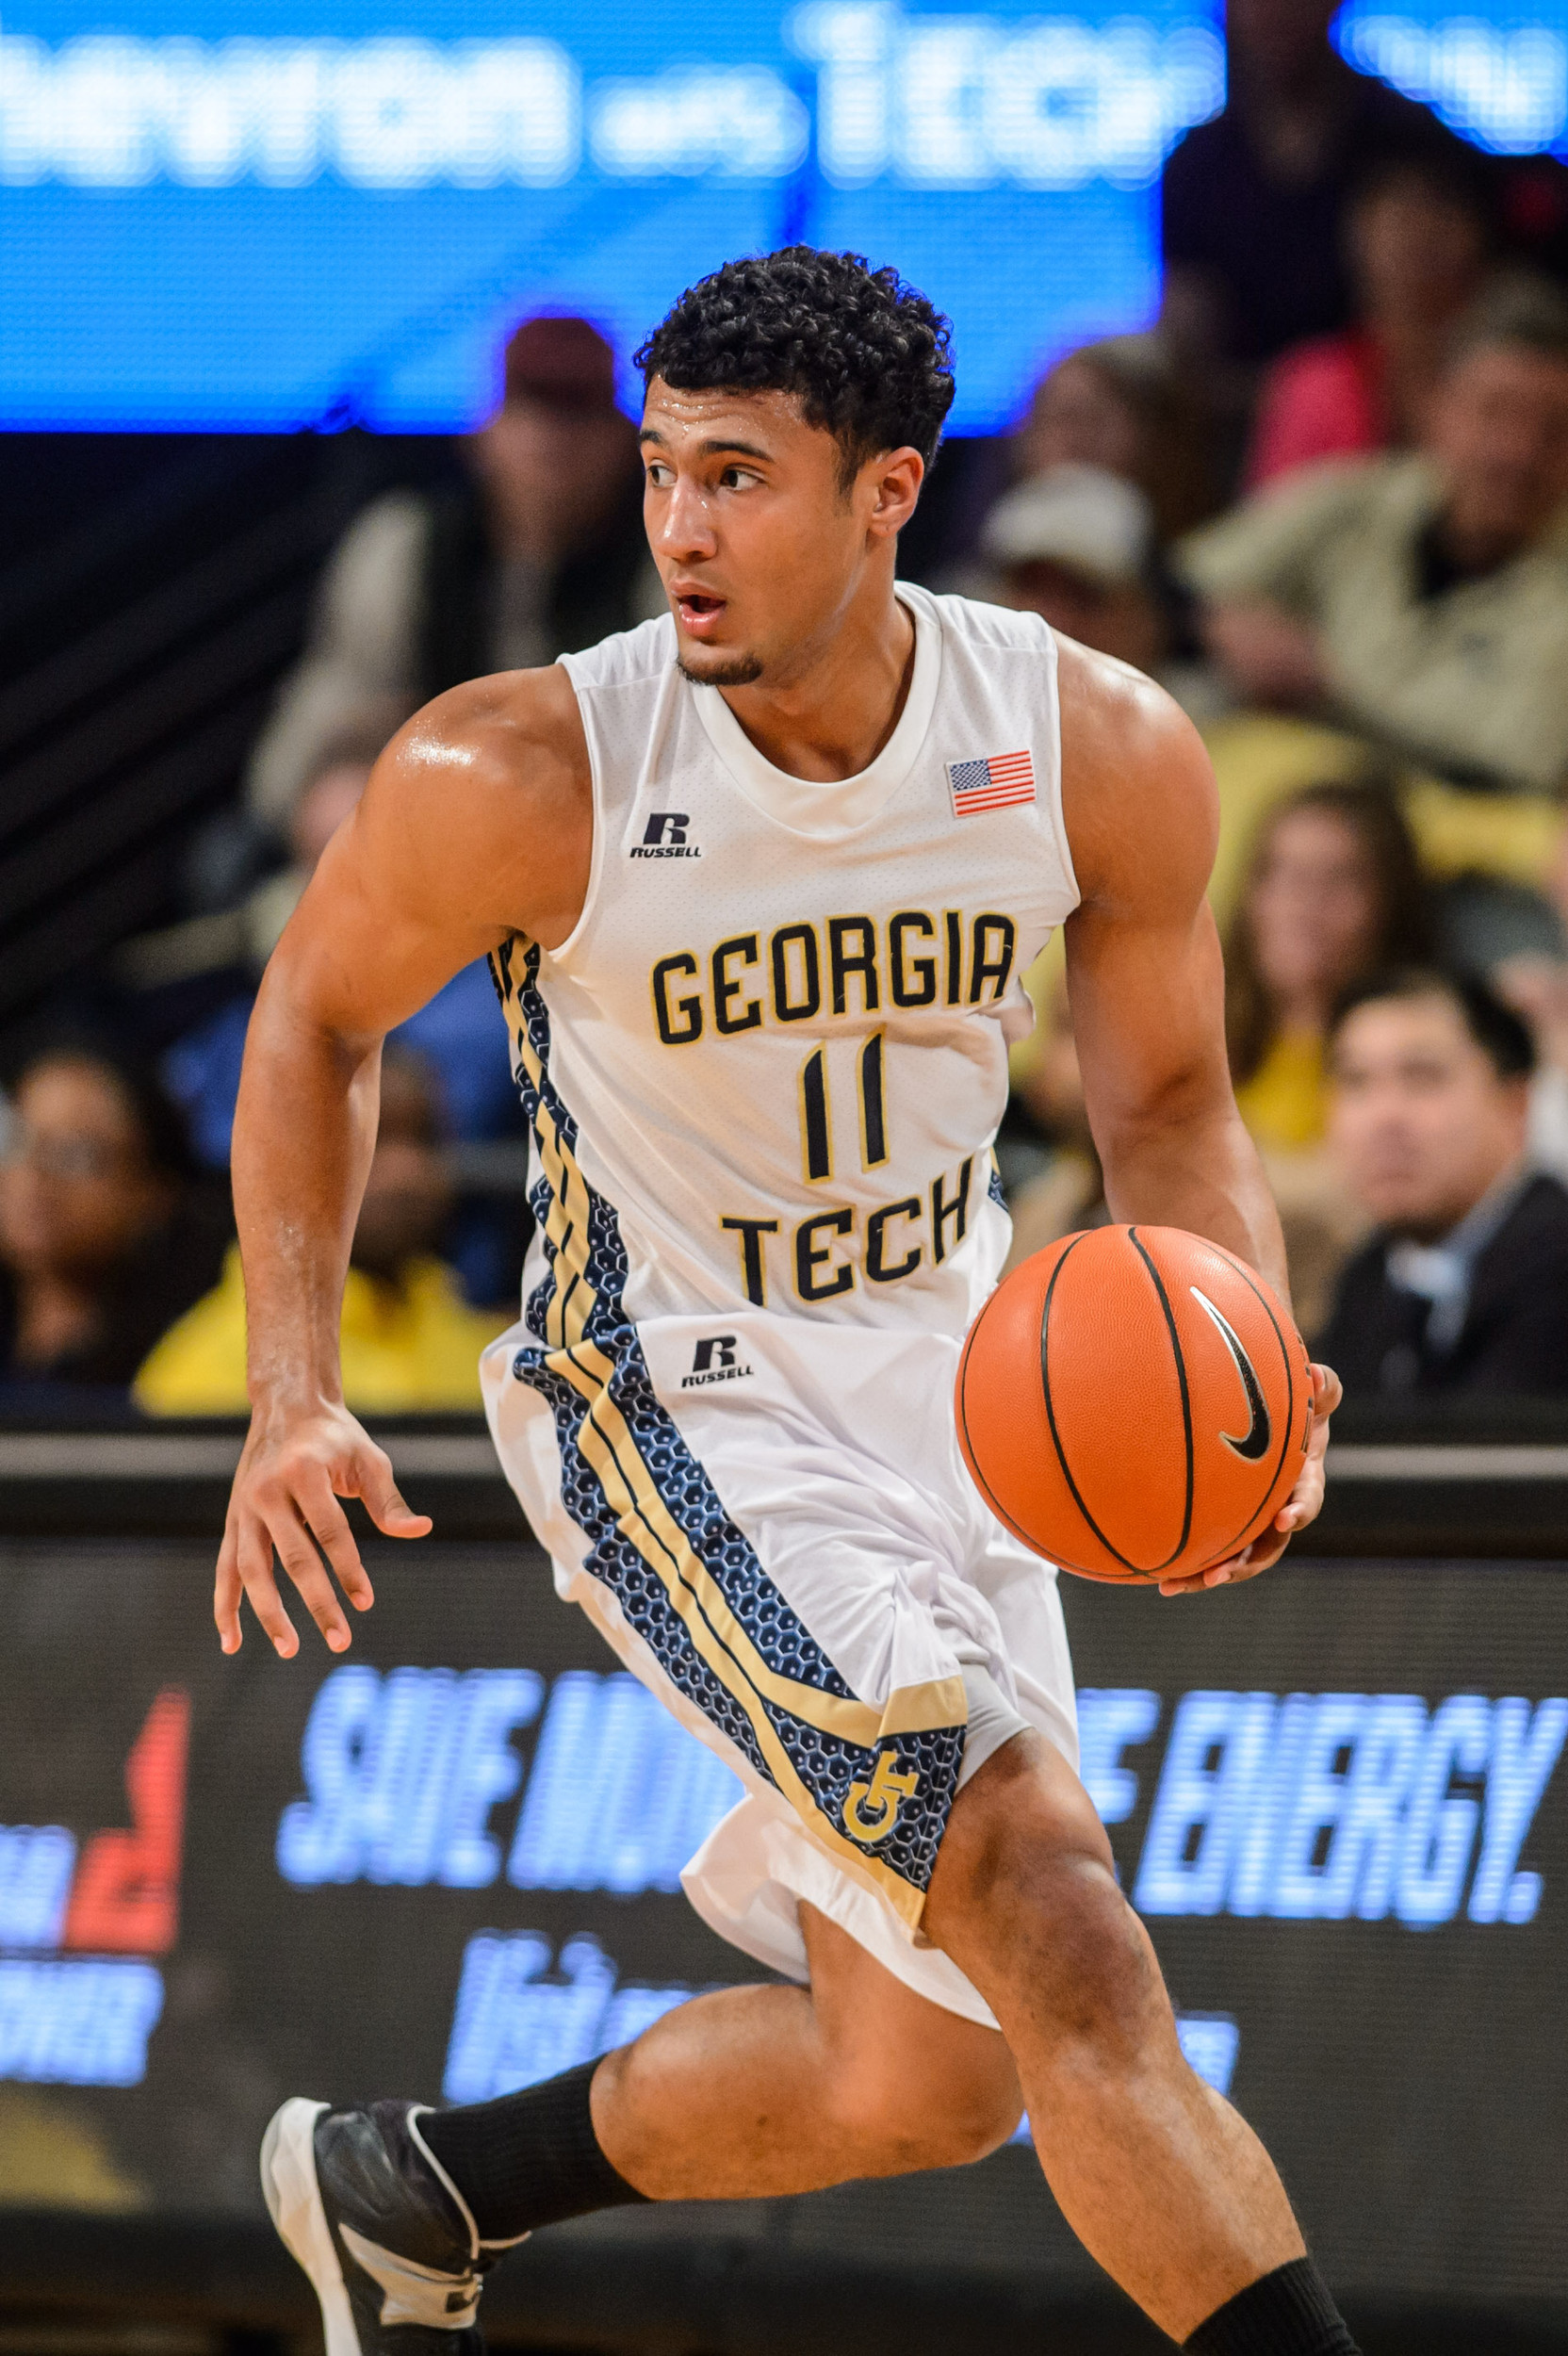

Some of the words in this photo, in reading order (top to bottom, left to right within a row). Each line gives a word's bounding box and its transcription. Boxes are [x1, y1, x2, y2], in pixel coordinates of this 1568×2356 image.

[629, 846, 702, 859] RUSSELL
[650, 908, 1019, 1048] GEORGIA
[798, 1023, 890, 1186] 11
[719, 1152, 975, 1308] TECH
[681, 1365, 754, 1388] RUSSELL
